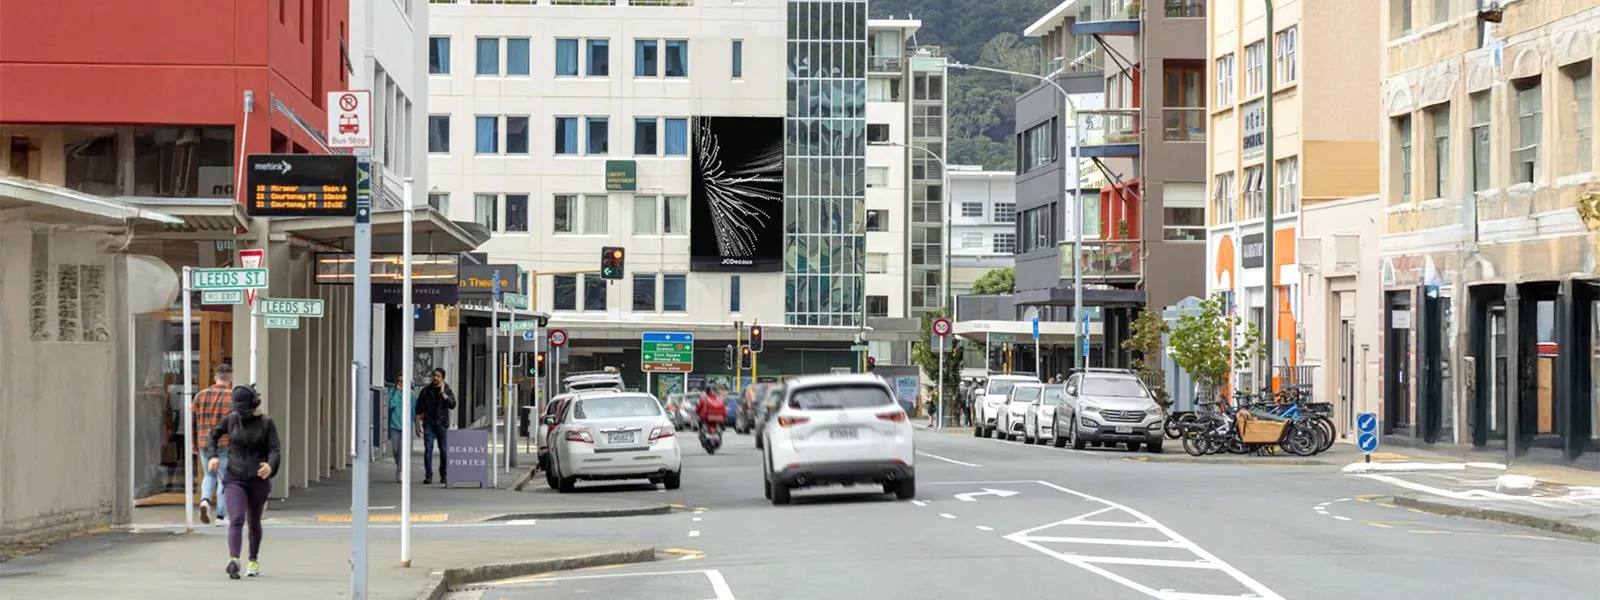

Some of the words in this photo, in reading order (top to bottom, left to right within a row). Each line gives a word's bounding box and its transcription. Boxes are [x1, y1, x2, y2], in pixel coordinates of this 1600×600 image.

[348, 137, 367, 146] Stop
[255, 162, 282, 171] metlink
[270, 193, 307, 201] Courtenay
[270, 201, 307, 209] Courtenay
[199, 272, 238, 286] LEEDS
[245, 271, 260, 285] ST
[470, 277, 508, 287] Theae
[266, 301, 299, 313] LEEDS
[303, 302, 315, 314] ST
[269, 318, 280, 326] NO
[280, 318, 294, 326] EXIT
[937, 323, 947, 331] 50
[553, 334, 563, 342] 50
